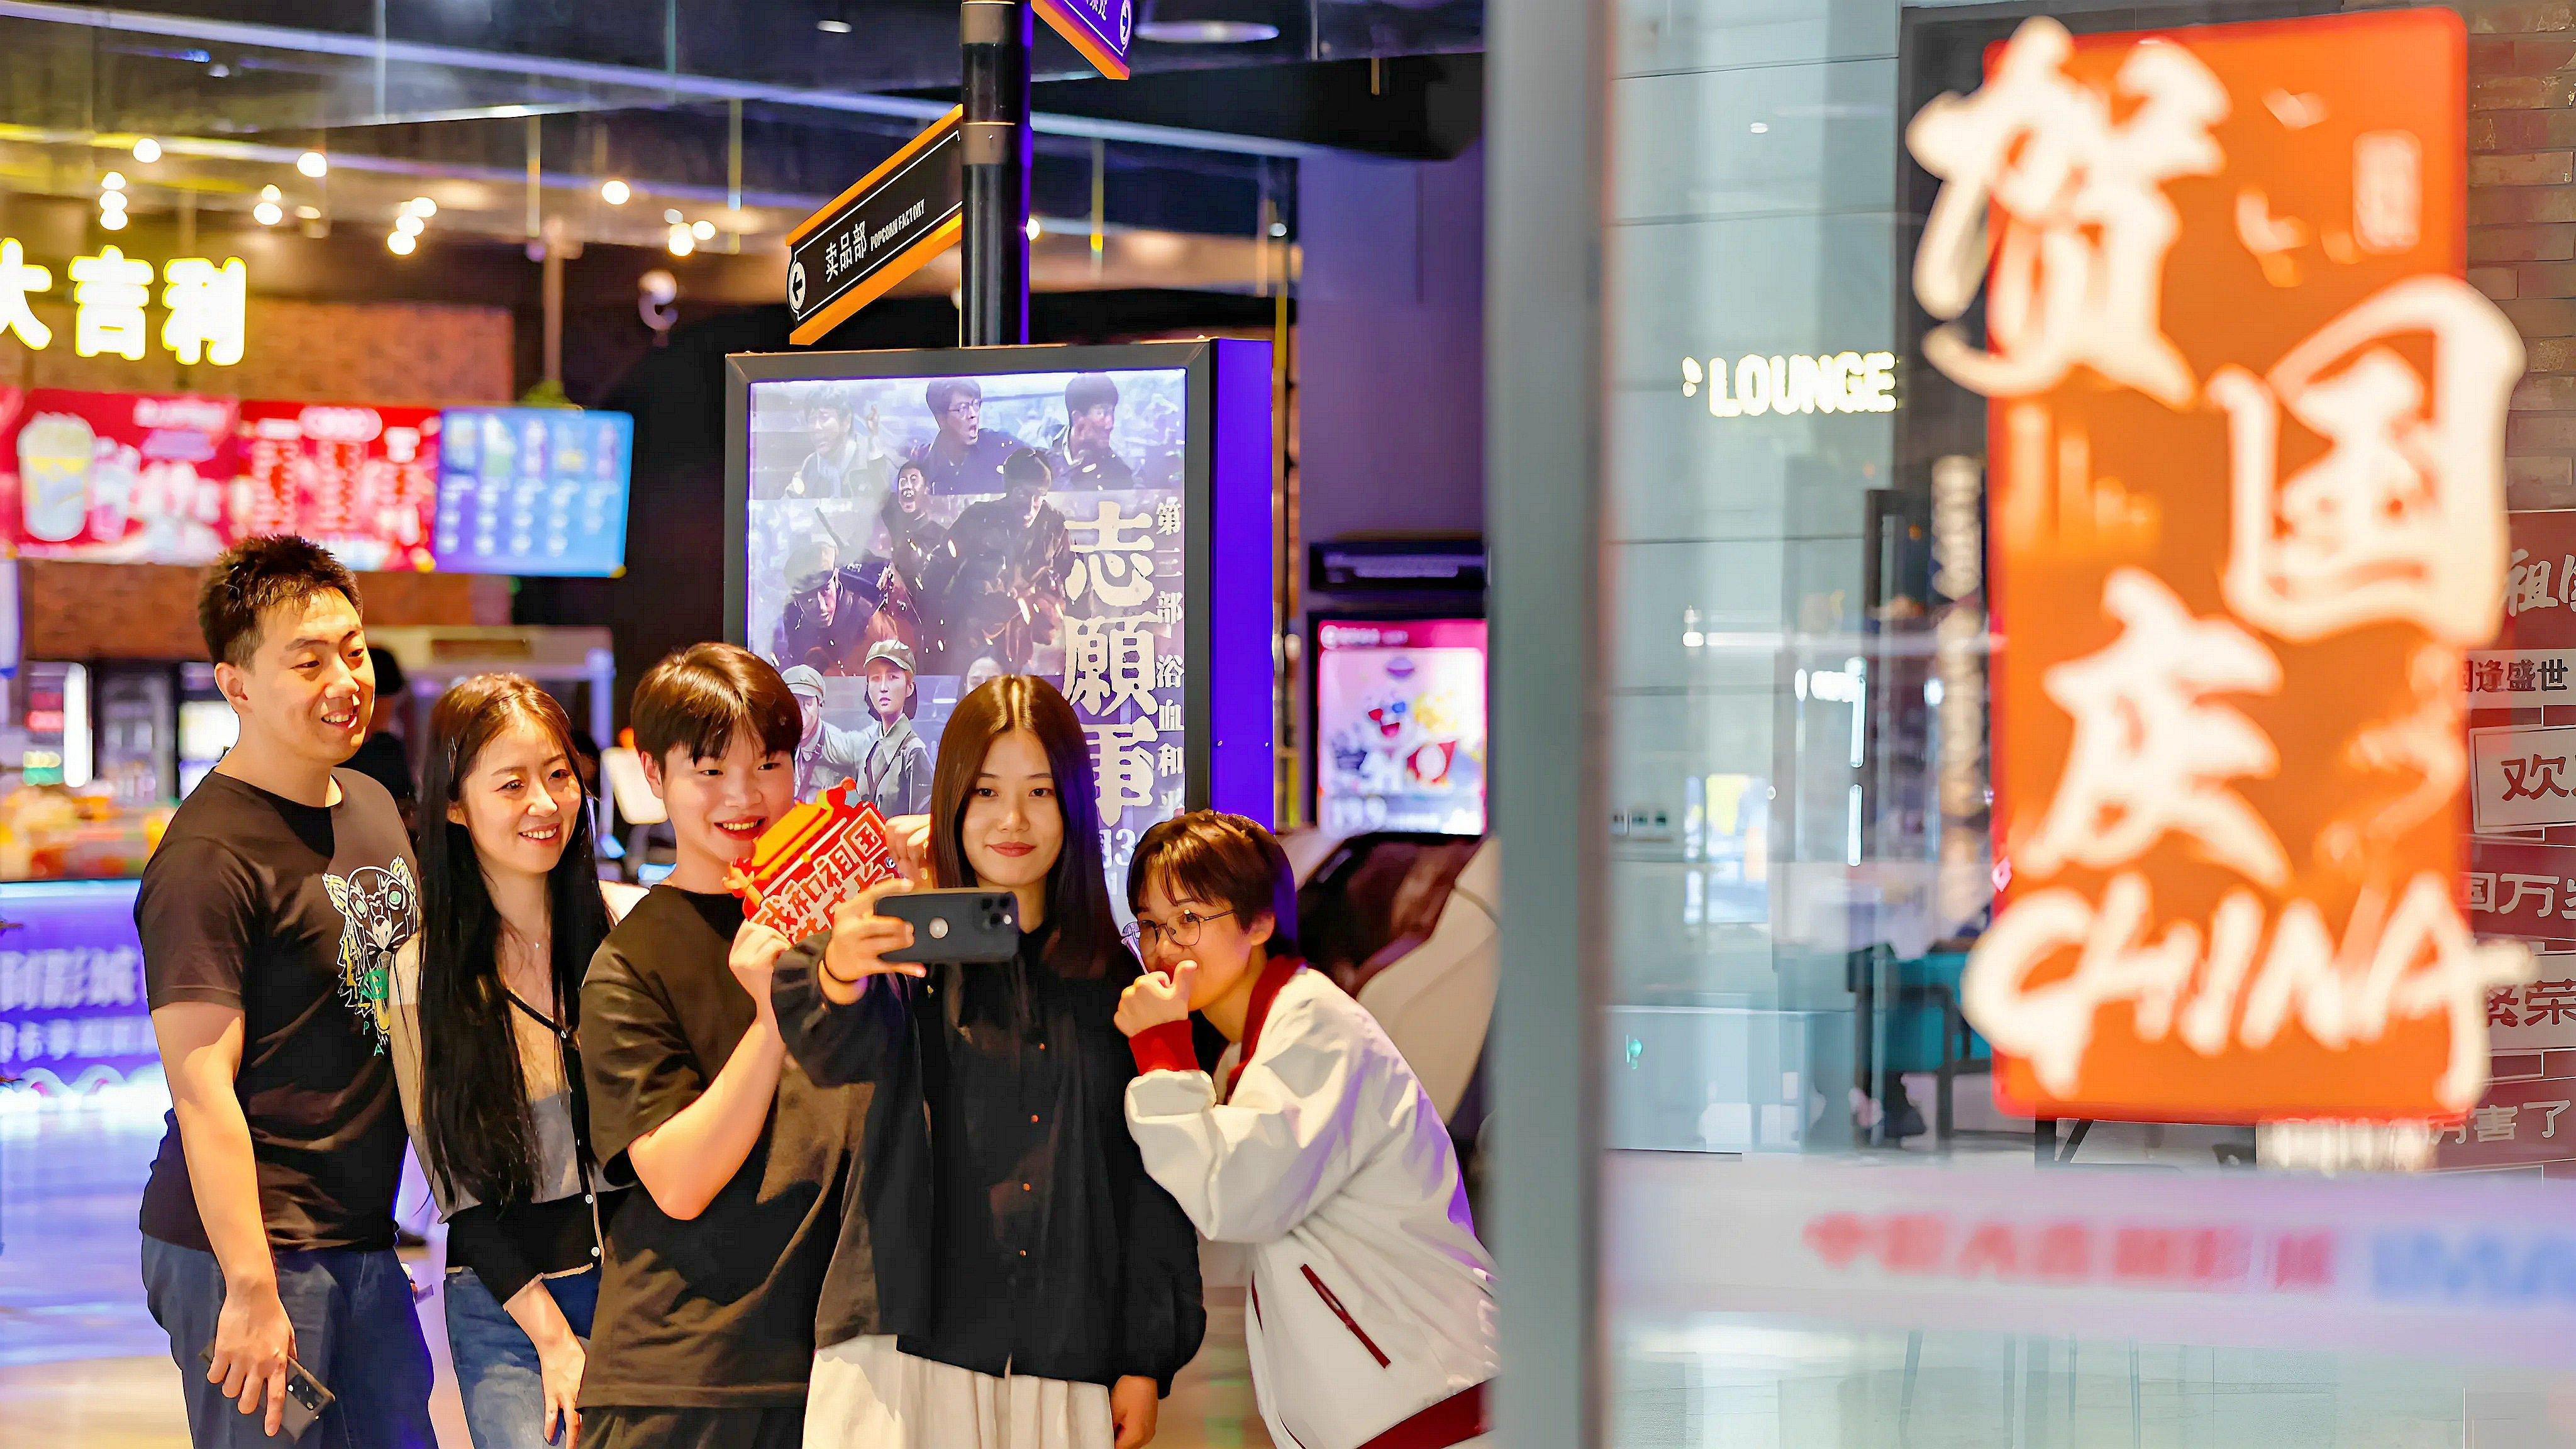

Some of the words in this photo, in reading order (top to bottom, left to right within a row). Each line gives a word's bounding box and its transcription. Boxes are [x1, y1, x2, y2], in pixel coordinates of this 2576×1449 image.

[825, 221, 867, 282] 卖品部
[870, 218, 899, 251] POPCORN
[898, 199, 925, 230] FACTORY
[0, 238, 246, 366] 大吉利
[1709, 351, 1897, 417] LOUNGE
[2506, 548, 2576, 617] 祖
[2501, 753, 2576, 801] 欢
[1961, 869, 2540, 1109] CHINA
